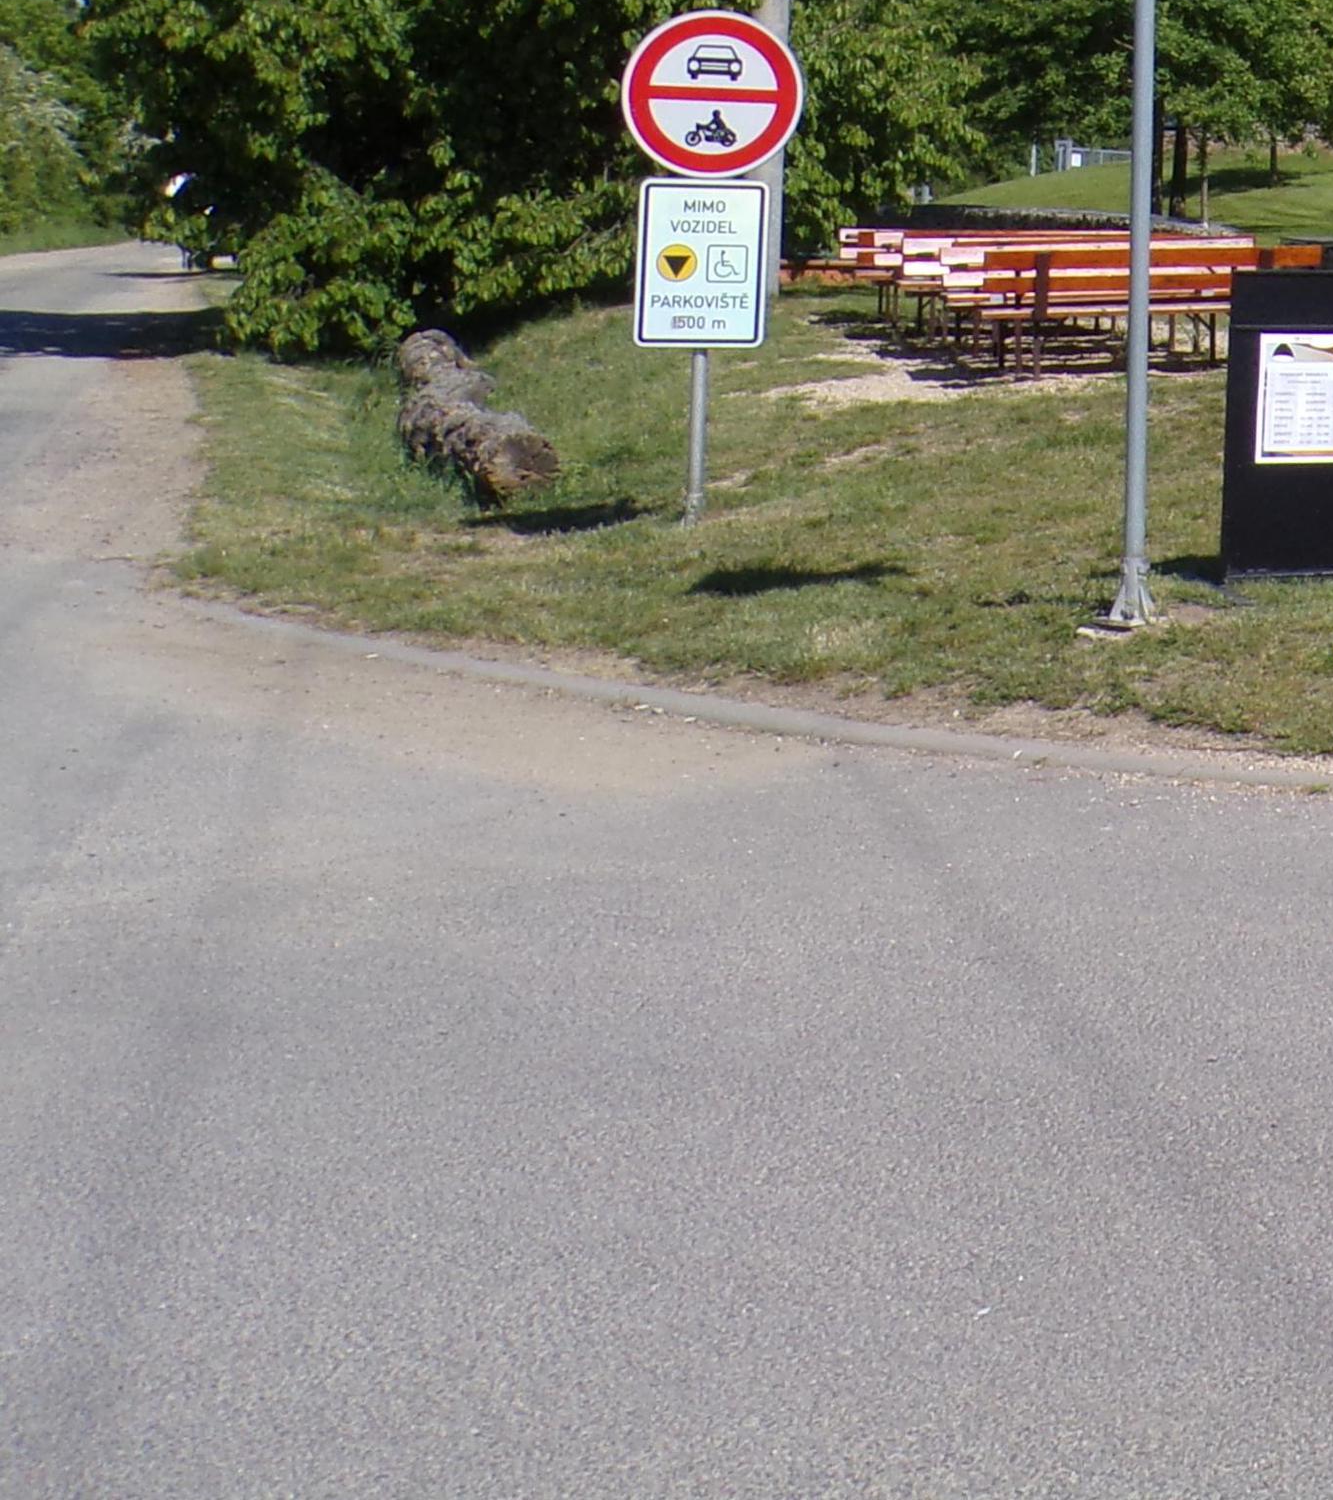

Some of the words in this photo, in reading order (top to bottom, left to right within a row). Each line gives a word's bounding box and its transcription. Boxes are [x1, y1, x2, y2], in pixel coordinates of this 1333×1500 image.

[683, 199, 727, 214] MIMO
[670, 219, 738, 235] VOZIDEL
[650, 292, 750, 310] PARKOVIŠTĚ
[711, 318, 727, 330] m
